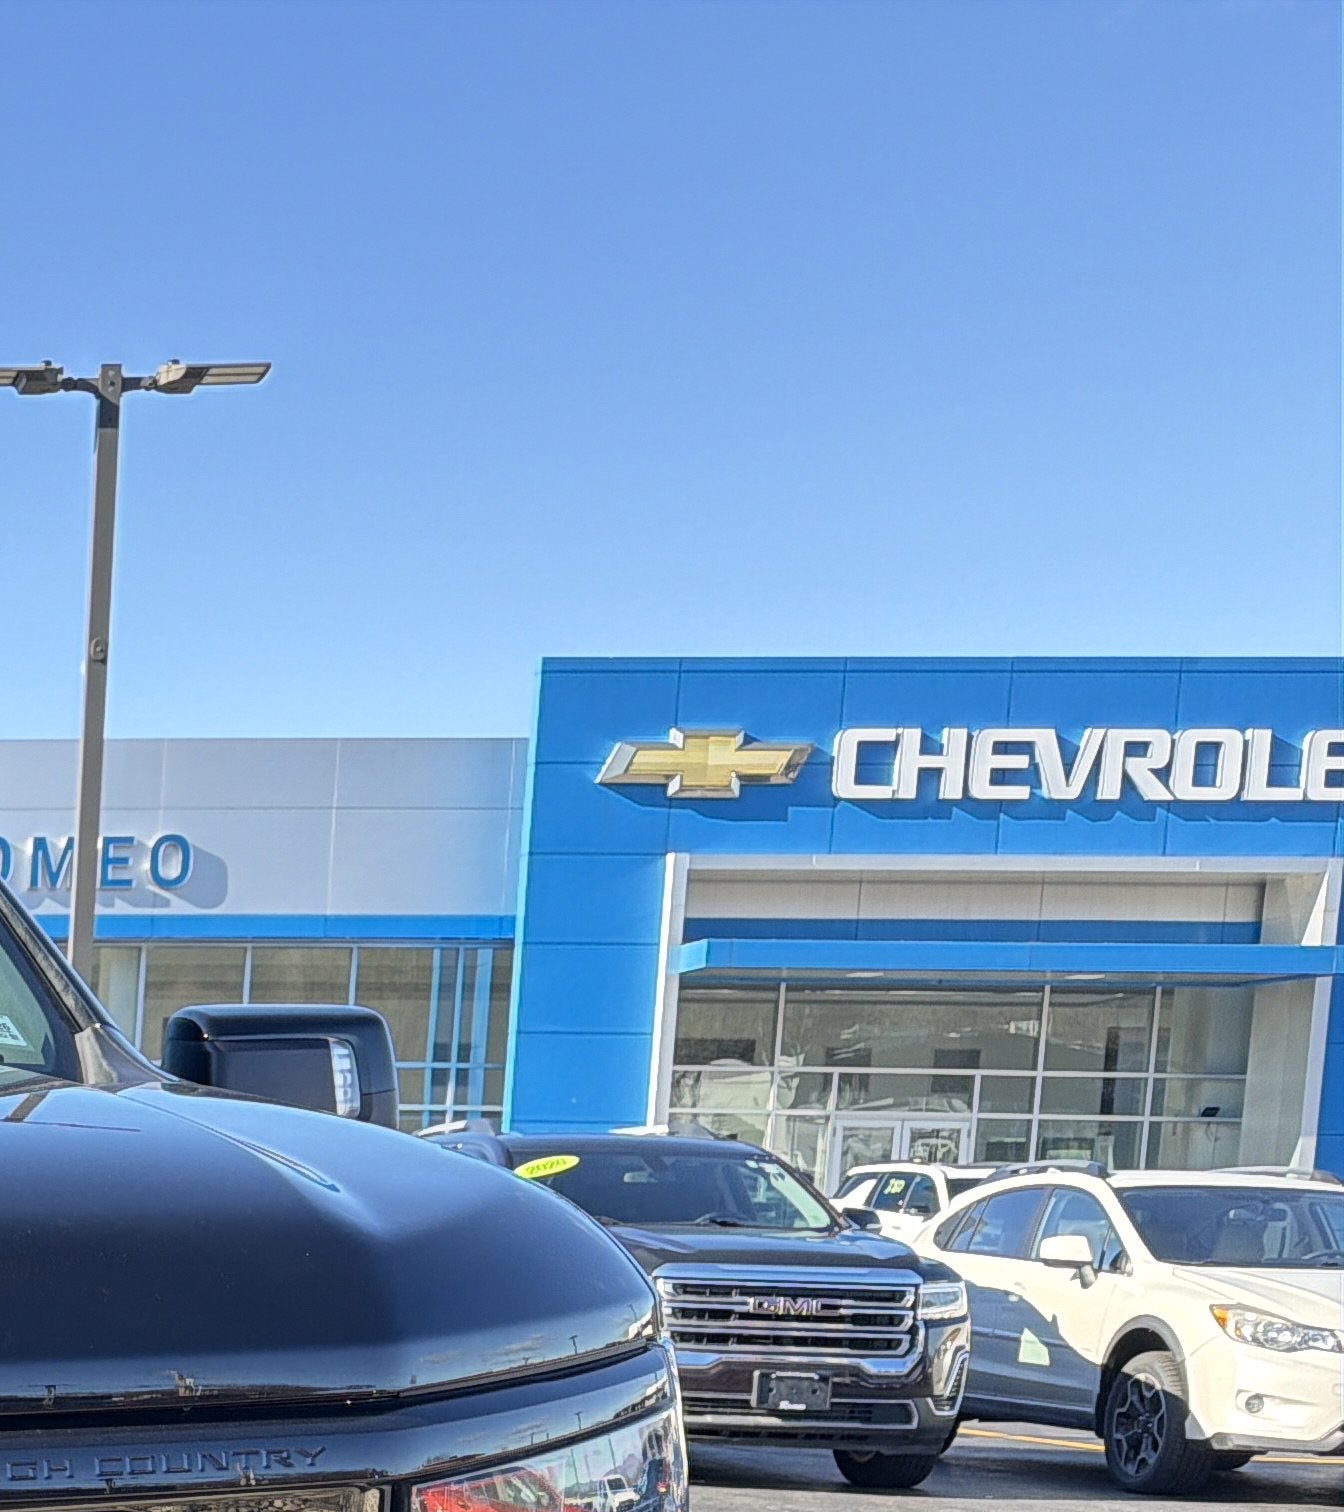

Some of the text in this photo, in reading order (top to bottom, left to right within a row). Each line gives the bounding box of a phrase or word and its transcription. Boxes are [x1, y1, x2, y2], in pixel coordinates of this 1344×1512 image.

[832, 727, 1344, 801] CHEVROLE
[749, 1296, 842, 1316] GMC
[93, 1445, 327, 1479] COUNTRY
